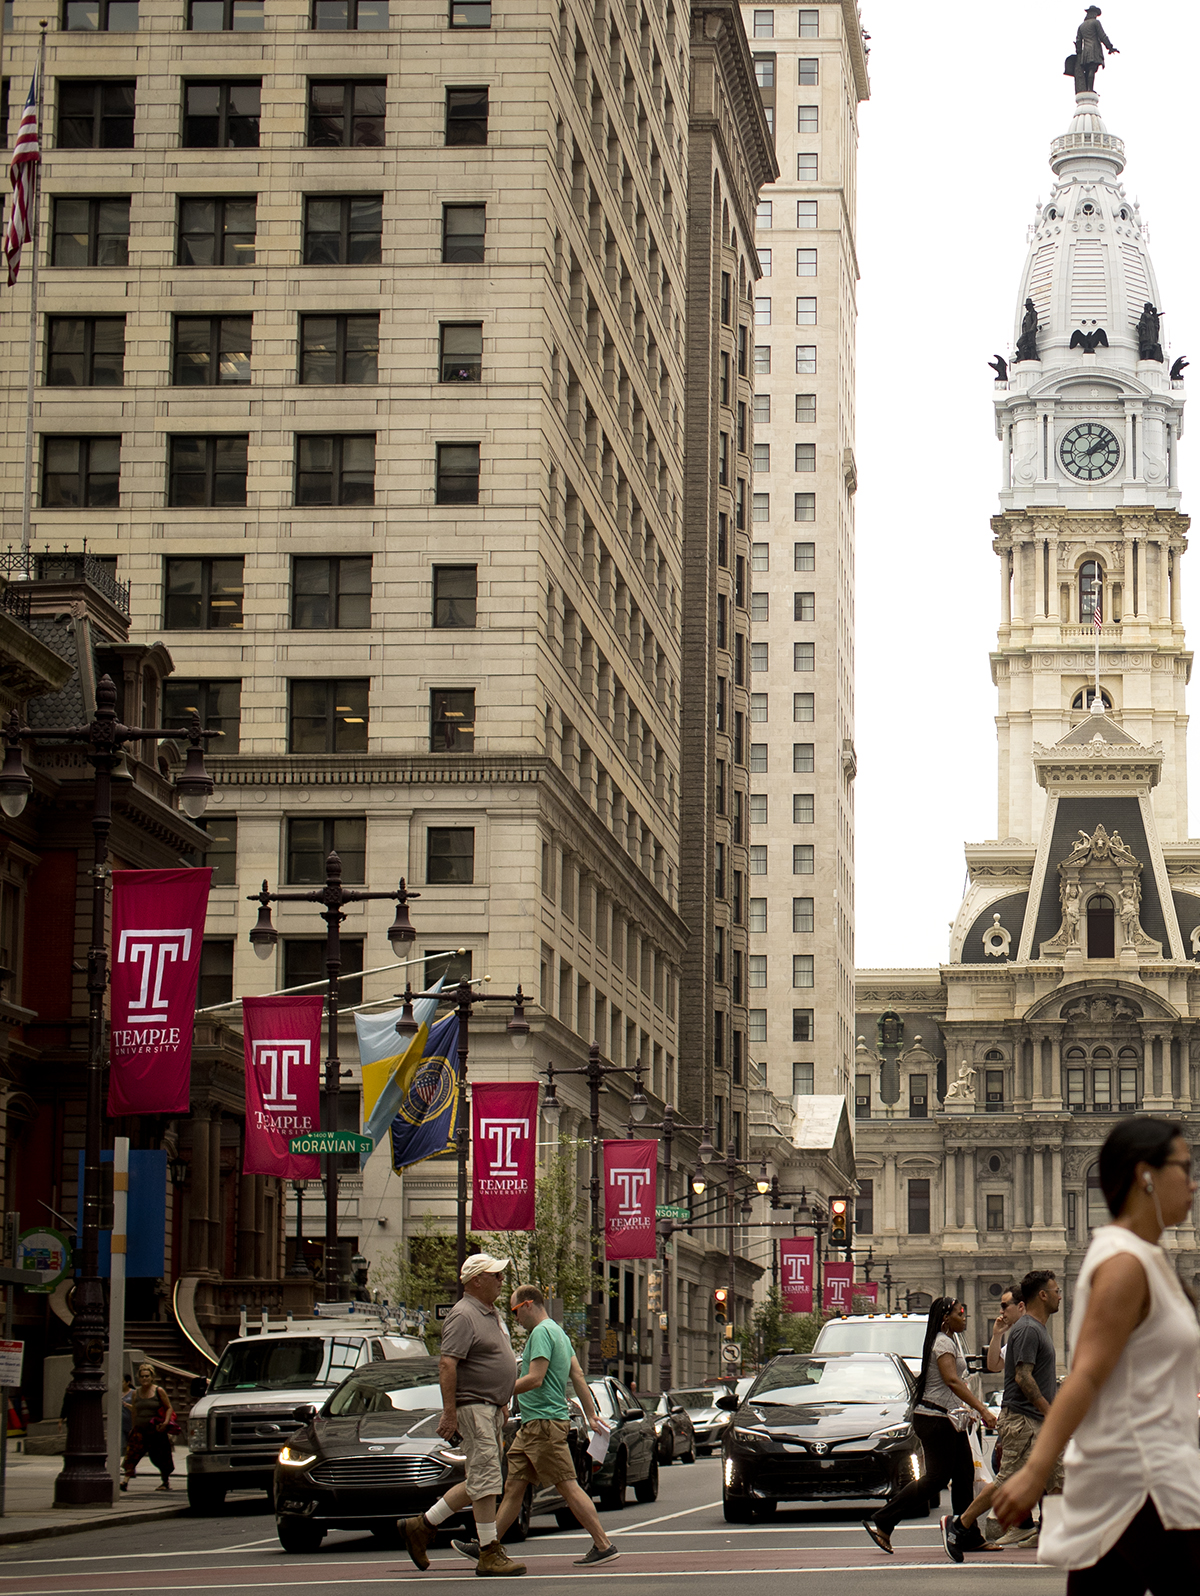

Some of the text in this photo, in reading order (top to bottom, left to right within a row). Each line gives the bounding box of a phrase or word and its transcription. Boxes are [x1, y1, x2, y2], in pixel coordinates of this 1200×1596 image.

[112, 1027, 181, 1047] TEMPLE
[115, 1044, 178, 1056] UNIVERSITY
[254, 1110, 313, 1129] TEMPLE
[291, 1140, 370, 1152] MORAVIAN ST
[478, 1178, 529, 1190] TEMPLE
[609, 1216, 651, 1227] TEMPLE
